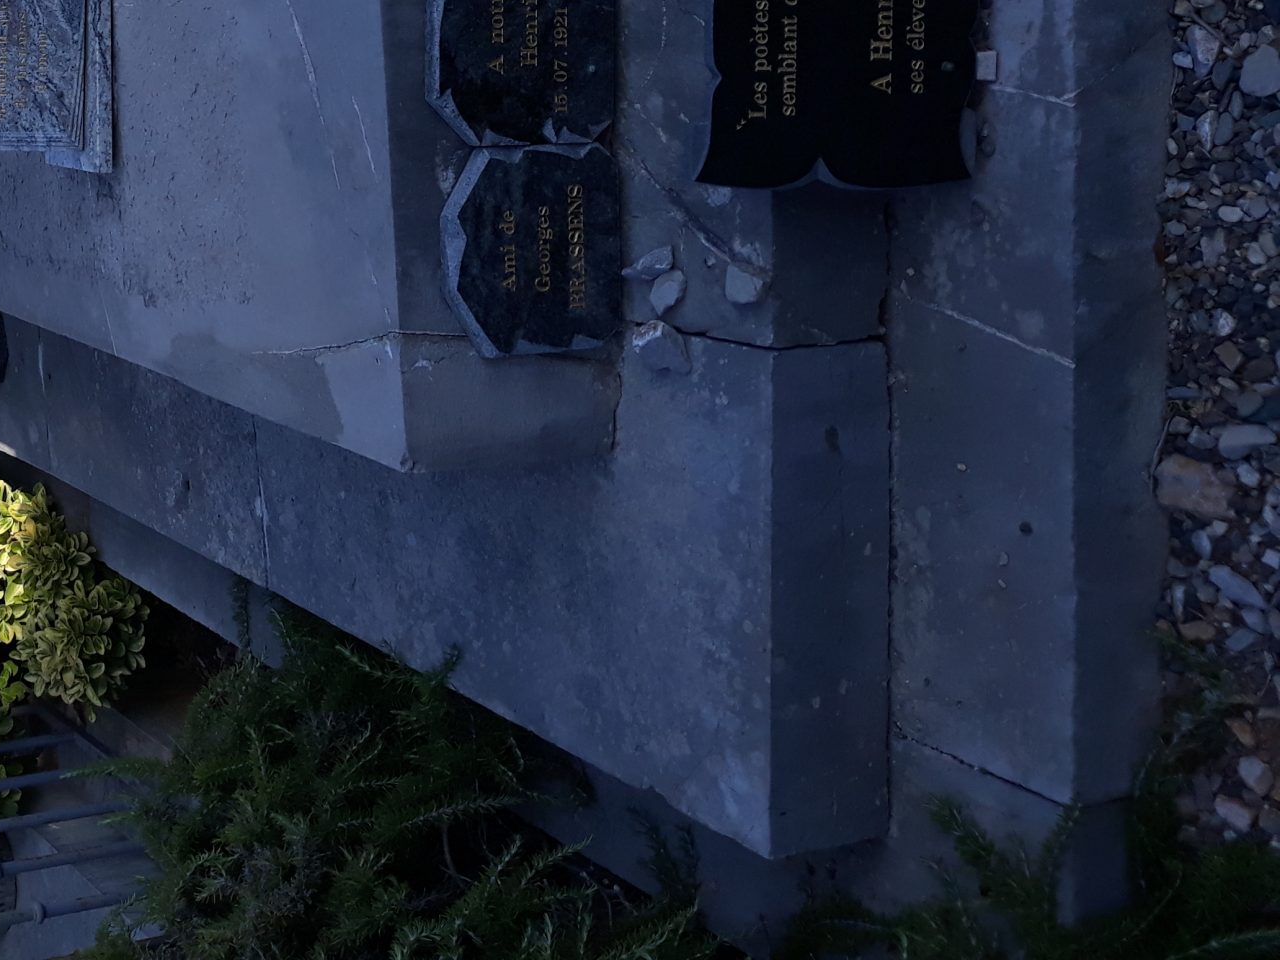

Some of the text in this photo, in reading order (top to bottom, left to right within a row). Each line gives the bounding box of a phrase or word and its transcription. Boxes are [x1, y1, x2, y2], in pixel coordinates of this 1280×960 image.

[488, 55, 504, 75] A
[748, 0, 772, 72] poètes
[778, 15, 798, 117] semblant
[870, 72, 892, 95] A
[908, 59, 925, 94] ses
[499, 210, 516, 291] Ami de
[535, 206, 553, 292] Georges
[568, 184, 586, 310] BRASSENS
